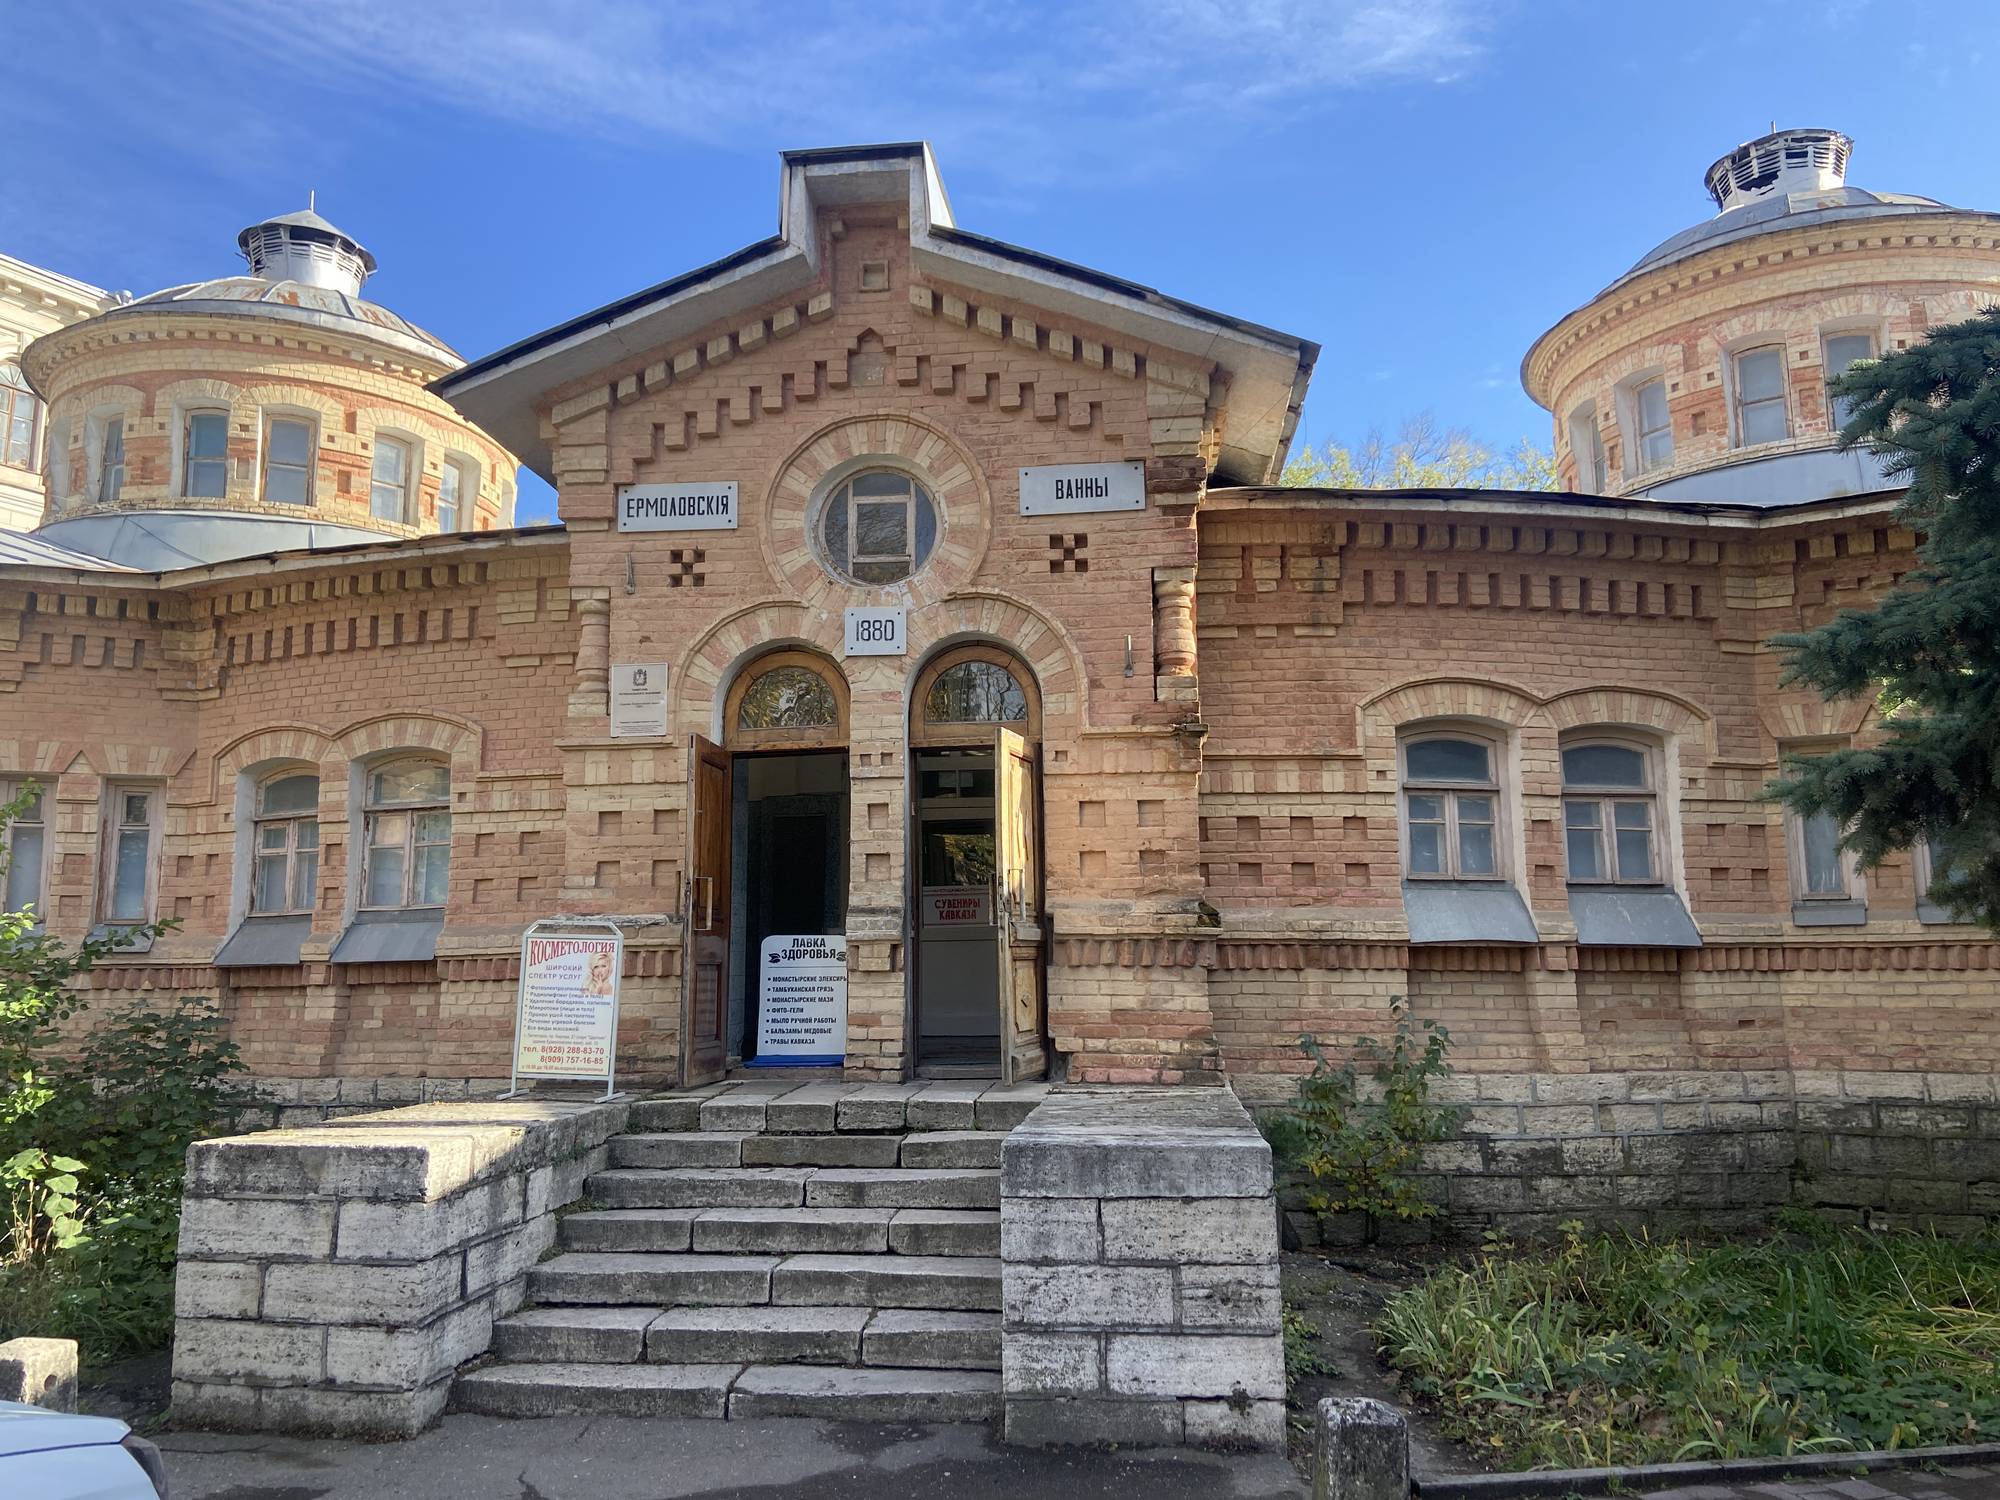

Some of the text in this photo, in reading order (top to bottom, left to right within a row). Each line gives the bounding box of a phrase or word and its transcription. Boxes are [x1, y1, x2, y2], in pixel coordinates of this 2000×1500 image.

[1055, 477, 1108, 500] ВАННЫ
[627, 495, 729, 518] ЕРМОЛОВСКІЯ
[856, 619, 895, 642] 1880
[934, 898, 981, 909] СУВЕНИРЫ
[939, 909, 977, 920] КАВКАЗА
[791, 937, 827, 949] ЛАВКА
[529, 940, 615, 966] КОСМЕТОЛОГИЯ
[781, 948, 836, 961] ЗДОРОВЬЯ
[541, 1046, 565, 1055] 8(928)
[567, 1047, 604, 1055] 288-83-70
[540, 1055, 564, 1064] 8(909)
